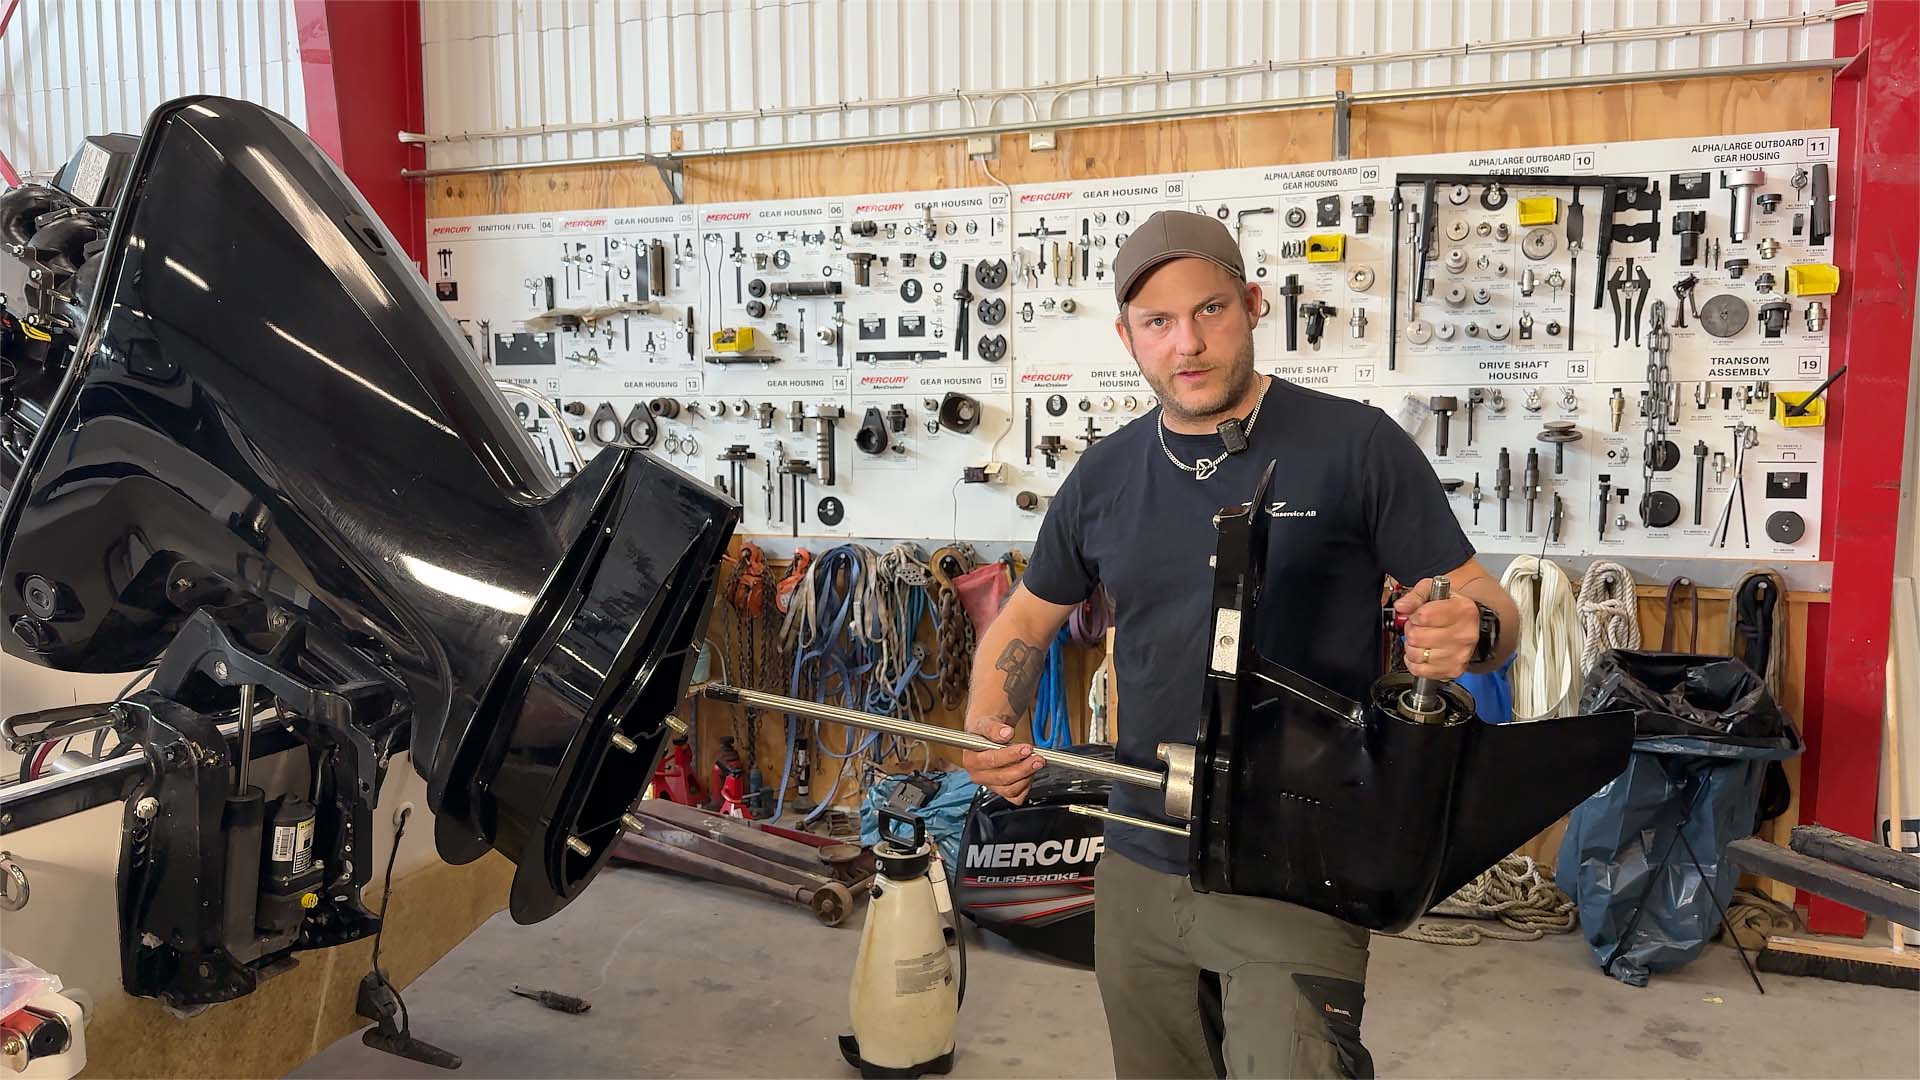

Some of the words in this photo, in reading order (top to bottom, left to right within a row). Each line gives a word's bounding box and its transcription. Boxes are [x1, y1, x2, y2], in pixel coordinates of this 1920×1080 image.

[1691, 141, 1752, 155] ALPHA/LARGE
[1754, 138, 1804, 151] OUTBOARD
[1810, 142, 1825, 151] 11
[1468, 156, 1524, 168] ALPHA/LARGE
[1526, 153, 1571, 165] OUTBOARD
[1577, 157, 1591, 166] 10
[1713, 152, 1738, 163] GEAR
[1739, 151, 1780, 162] HOUSING
[1264, 170, 1315, 181] ALPHA/LARGE
[1317, 167, 1358, 178] OUTBOARD
[1363, 170, 1377, 180] 09
[1489, 168, 1511, 176] GEAR
[1512, 165, 1549, 176] HOUSING
[1168, 184, 1181, 194] 08
[1282, 181, 1301, 191] GEAR
[1303, 179, 1338, 190] HOUSING
[1020, 191, 1073, 204] MERCURY
[1083, 189, 1109, 199] GEAR
[1112, 186, 1158, 198] HOUSING
[914, 200, 938, 209] GEAR
[941, 198, 983, 208] HOUSING
[992, 196, 1003, 205] 07
[759, 210, 782, 218] GEAR
[784, 208, 822, 217] HOUSING
[831, 206, 841, 215] 06
[856, 203, 904, 213] MERCURY
[614, 217, 635, 226] GEAR
[637, 216, 674, 225] HOUSING
[681, 214, 692, 223] 05
[706, 212, 751, 222] MERCURY
[478, 224, 512, 233] IGNITION
[517, 223, 535, 231] FUEL
[541, 221, 552, 229] 04
[564, 220, 607, 228] MERCURY
[432, 225, 471, 236] MERCURY
[1478, 361, 1511, 371] DRIVE
[1514, 359, 1549, 370] SHAFT
[1710, 356, 1770, 366] TRANSOM
[1802, 359, 1818, 370] 19
[1274, 366, 1304, 375] DRIVE
[1306, 365, 1338, 375] SHAFT
[1358, 368, 1371, 379] 17
[1570, 364, 1585, 374] 18
[1709, 367, 1771, 377] ASSEMBLY
[1021, 373, 1073, 384] MERCURY
[1090, 370, 1118, 379] DRIVE
[1488, 370, 1539, 381] HOUSING
[548, 381, 557, 389] 12
[645, 380, 678, 388] HOUSING
[687, 381, 697, 389] 13
[789, 379, 824, 387] HOUSING
[835, 379, 845, 387] 14
[860, 376, 909, 385] MERCURY
[920, 378, 942, 386] GEAR
[943, 377, 982, 386] HOUSING
[993, 377, 1004, 385] 15
[1099, 379, 1140, 388] HOUSING
[965, 836, 1105, 868] MERCUR
